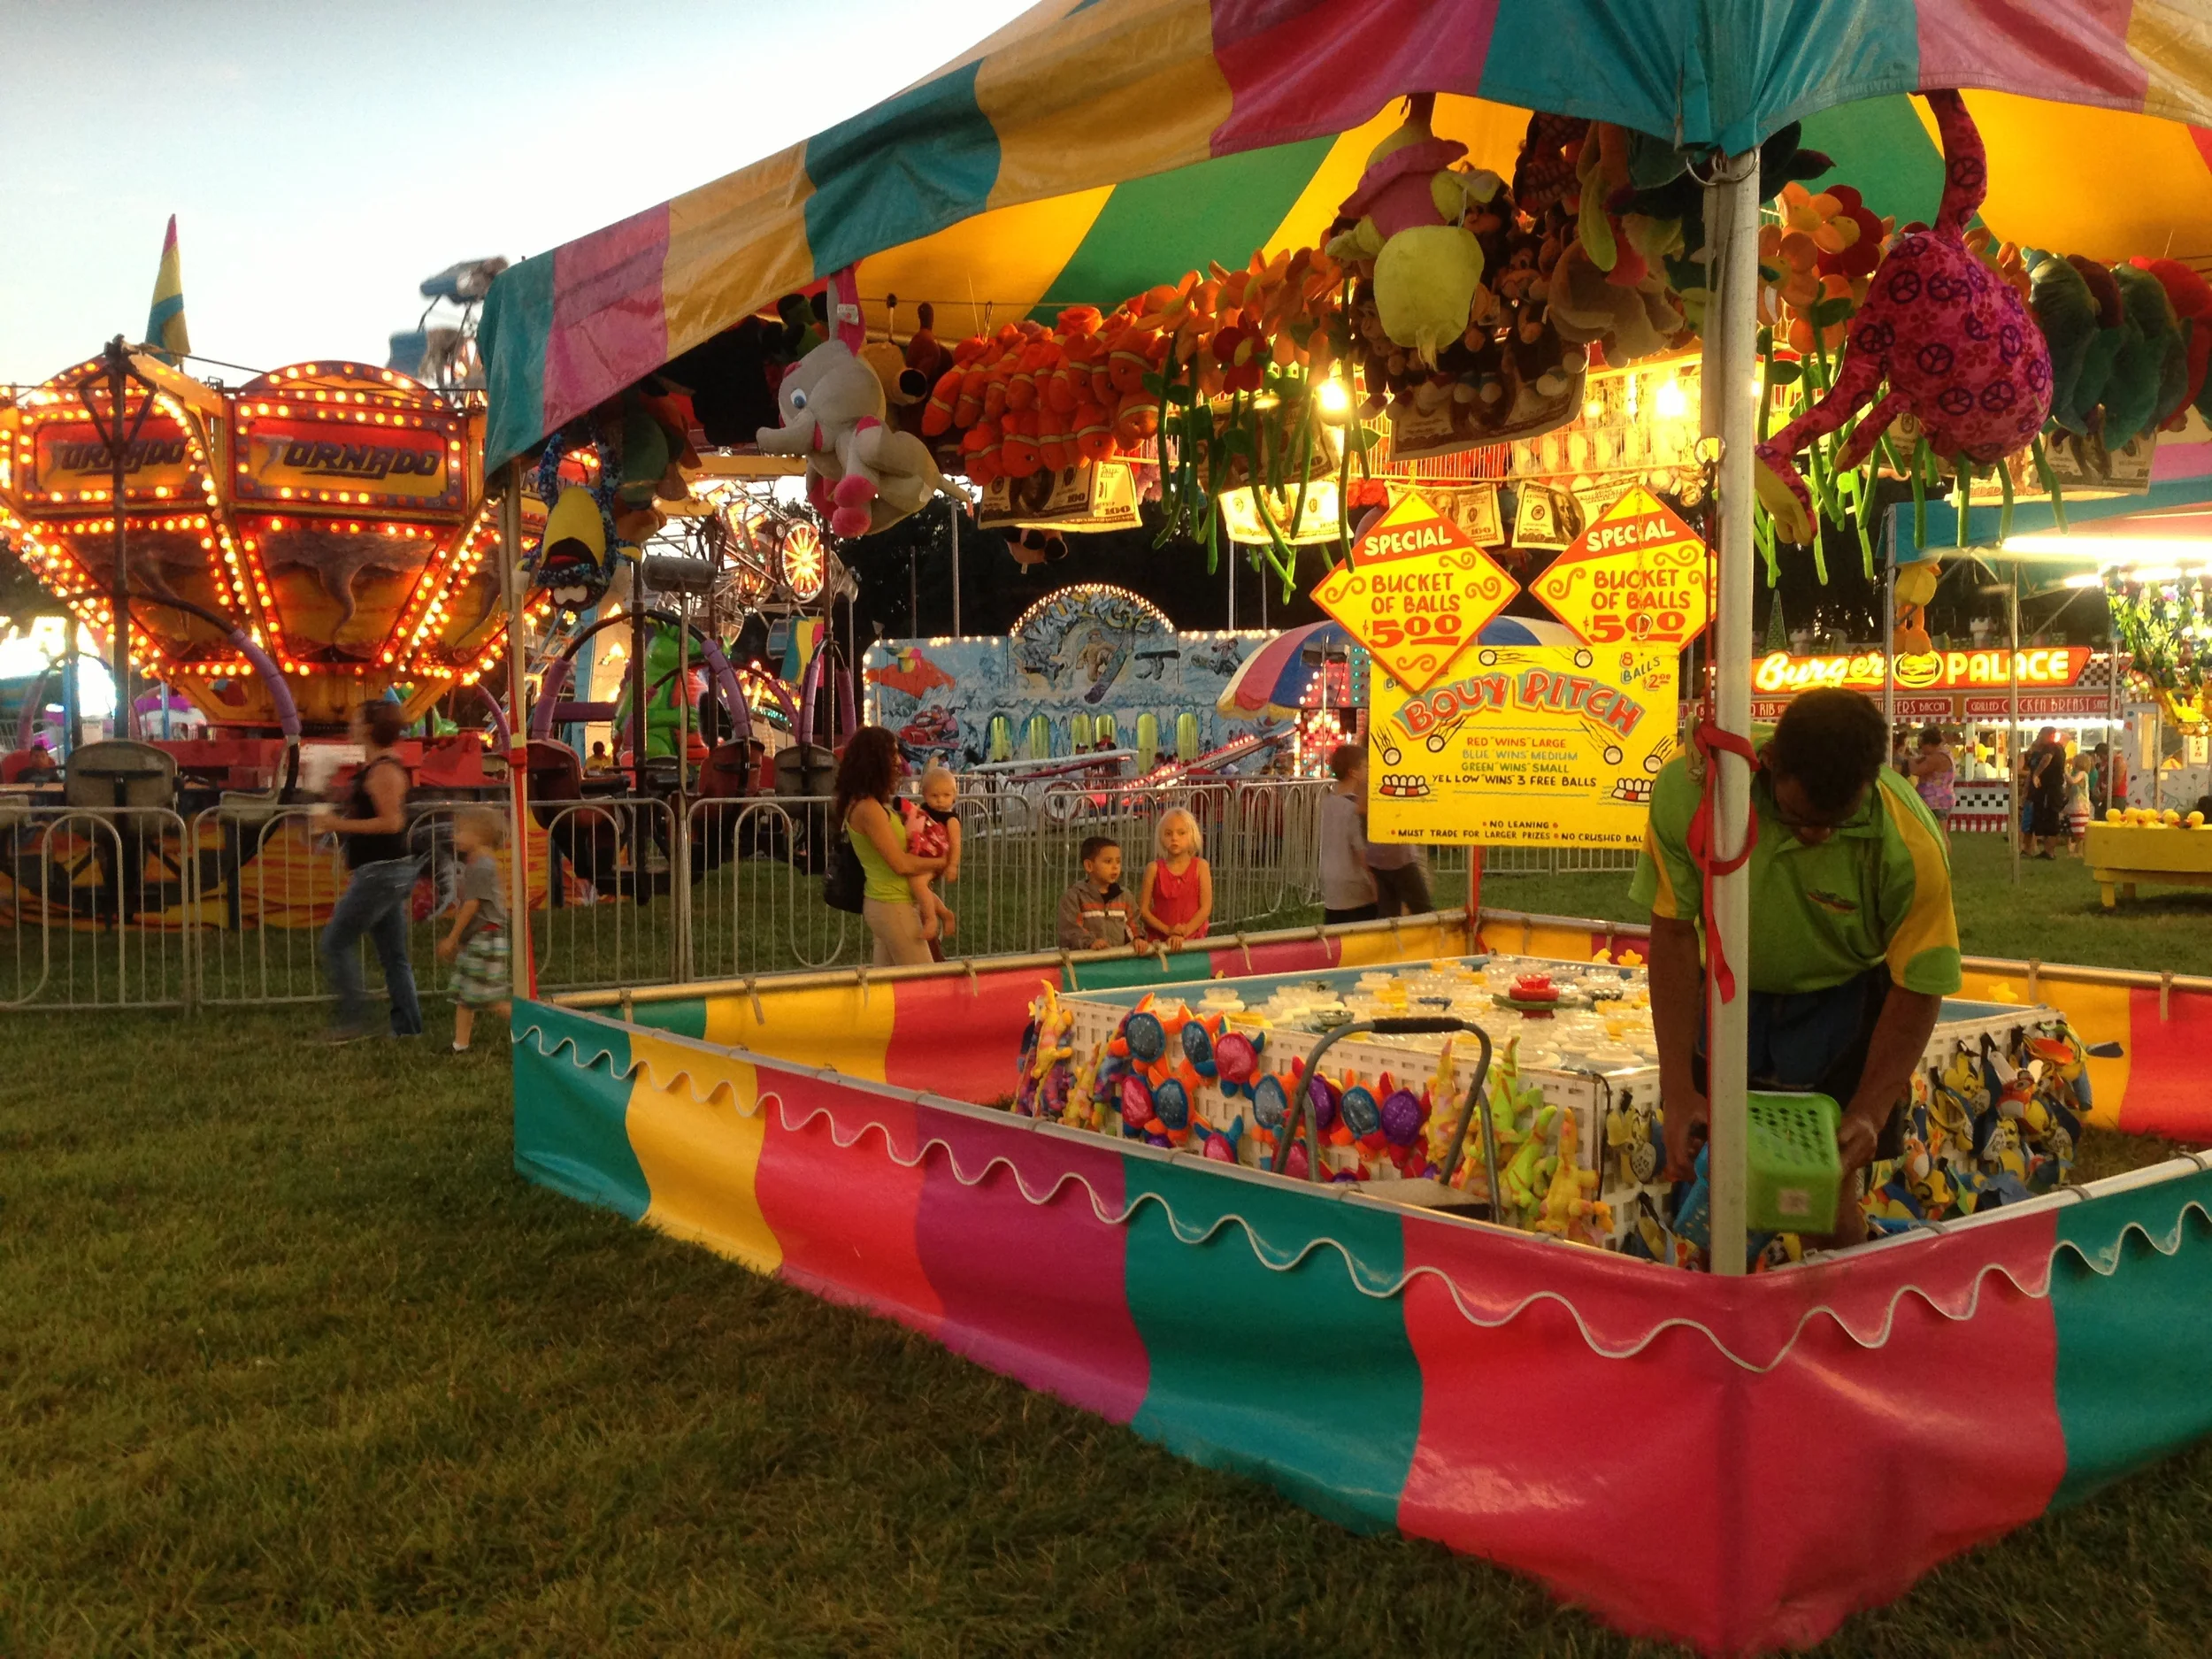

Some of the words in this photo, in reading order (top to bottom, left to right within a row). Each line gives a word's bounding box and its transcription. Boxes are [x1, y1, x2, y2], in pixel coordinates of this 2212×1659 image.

[253, 433, 443, 480] TORNADO
[1363, 525, 1453, 557] SPECIAL
[1586, 518, 1677, 553] SPECIAL
[1371, 572, 1455, 594] BUCKET
[1594, 568, 1679, 589] BUCKET
[1371, 595, 1396, 615] OF
[1403, 594, 1461, 614] BALLS
[1590, 591, 1620, 611] OF
[1626, 590, 1691, 611] BALLS
[1620, 651, 1634, 667] 8
[1621, 656, 1661, 684] BALLS
[1755, 651, 1887, 690] Burger
[1947, 649, 2070, 685] PALACE
[1398, 674, 1510, 736] BOUY
[1519, 669, 1644, 736] PITCH
[1759, 703, 1776, 717] RIB
[1919, 702, 1946, 712] BACON
[1970, 701, 2000, 711] GRILLED
[2001, 699, 2047, 713] CCKEN
[2051, 698, 2091, 712] BREAST
[1467, 737, 1488, 747] RED
[1532, 738, 1567, 749] LARGE
[1463, 749, 1489, 759] BLUE
[1531, 751, 1578, 761] MEDIUM
[1462, 762, 1494, 772] GREEN
[1532, 764, 1570, 773] SMALL
[1517, 775, 1526, 786] 3
[1530, 776, 1556, 786] FREE
[1561, 777, 1597, 787] BALLS
[1489, 820, 1504, 829] NO
[1508, 821, 1549, 830] LEANING
[1398, 829, 1425, 838] MUST
[1430, 830, 1458, 839] TRADE
[1463, 830, 1480, 839] FOR
[1485, 831, 1517, 840] LARGER
[1522, 831, 1551, 840] PRIZES
[1578, 833, 1622, 842] CRUSHED
[1626, 834, 1644, 843] BAL
